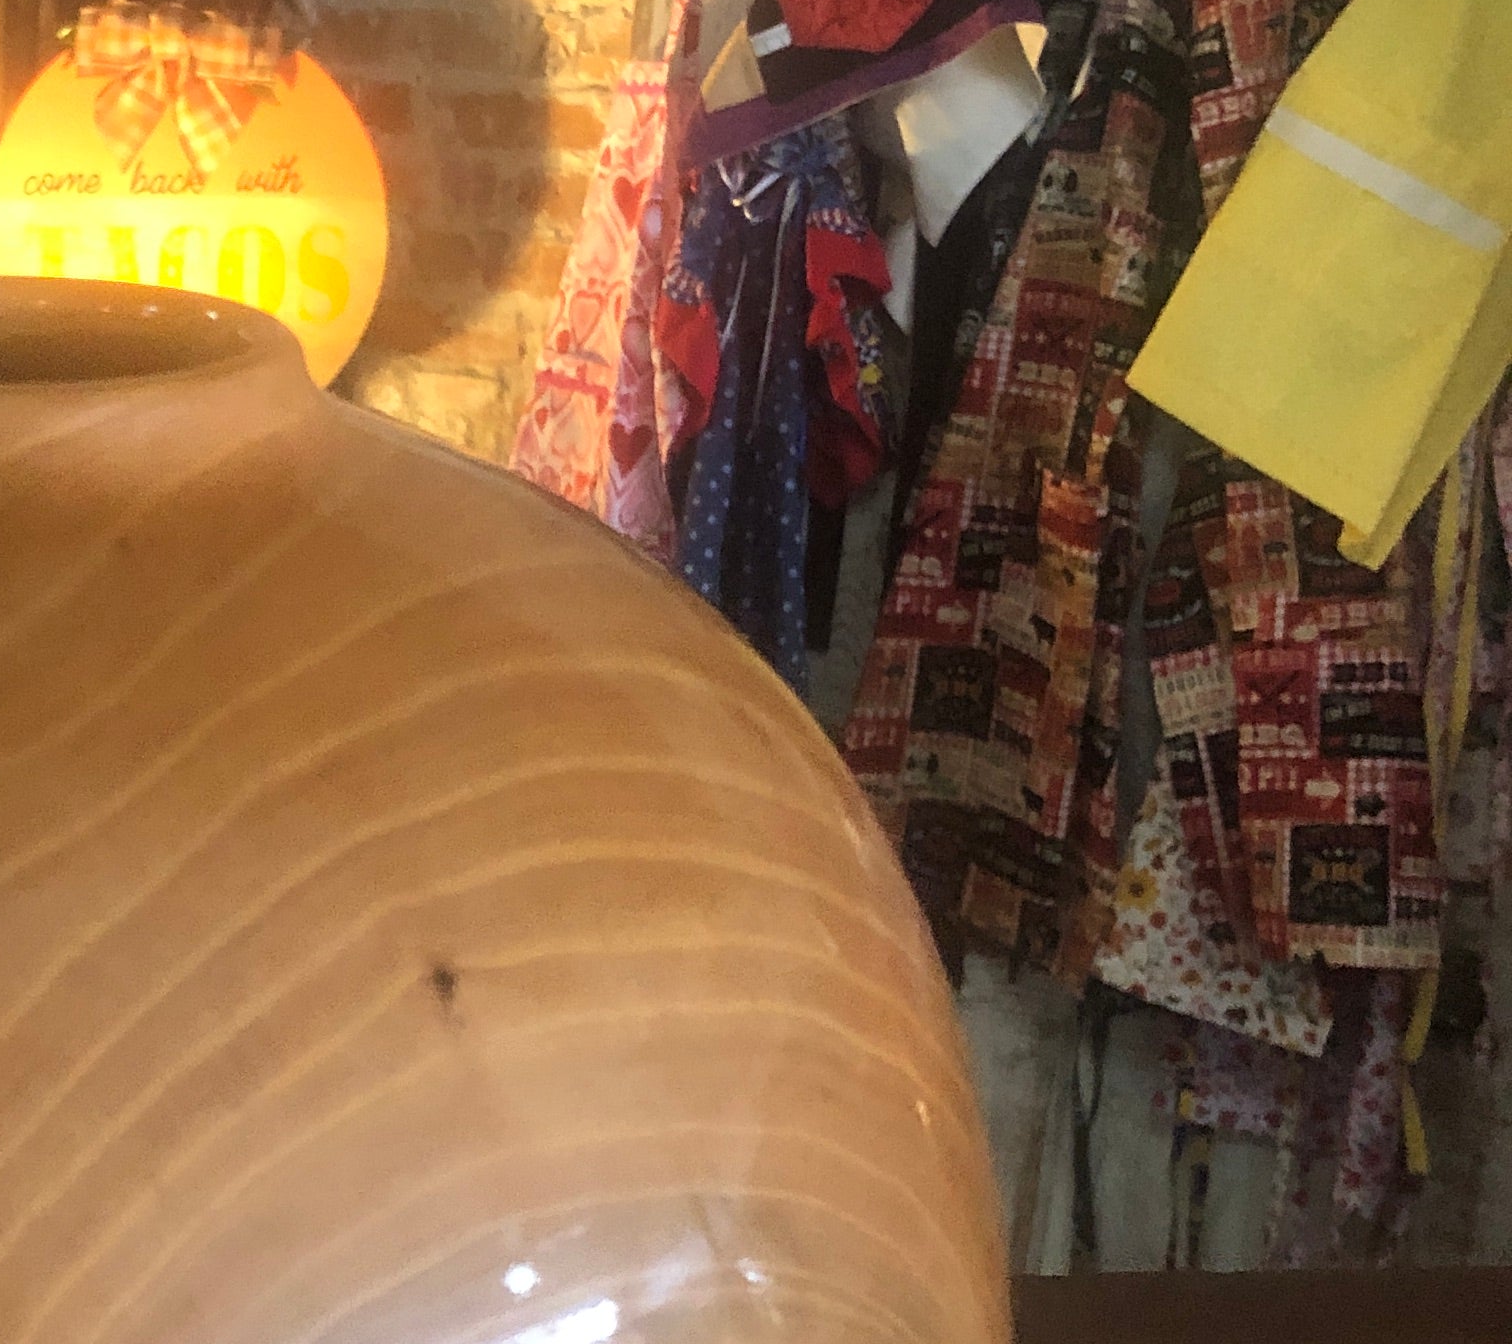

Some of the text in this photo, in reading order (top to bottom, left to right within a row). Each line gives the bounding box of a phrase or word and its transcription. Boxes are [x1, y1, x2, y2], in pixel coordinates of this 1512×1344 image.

[23, 154, 303, 196] come back with
